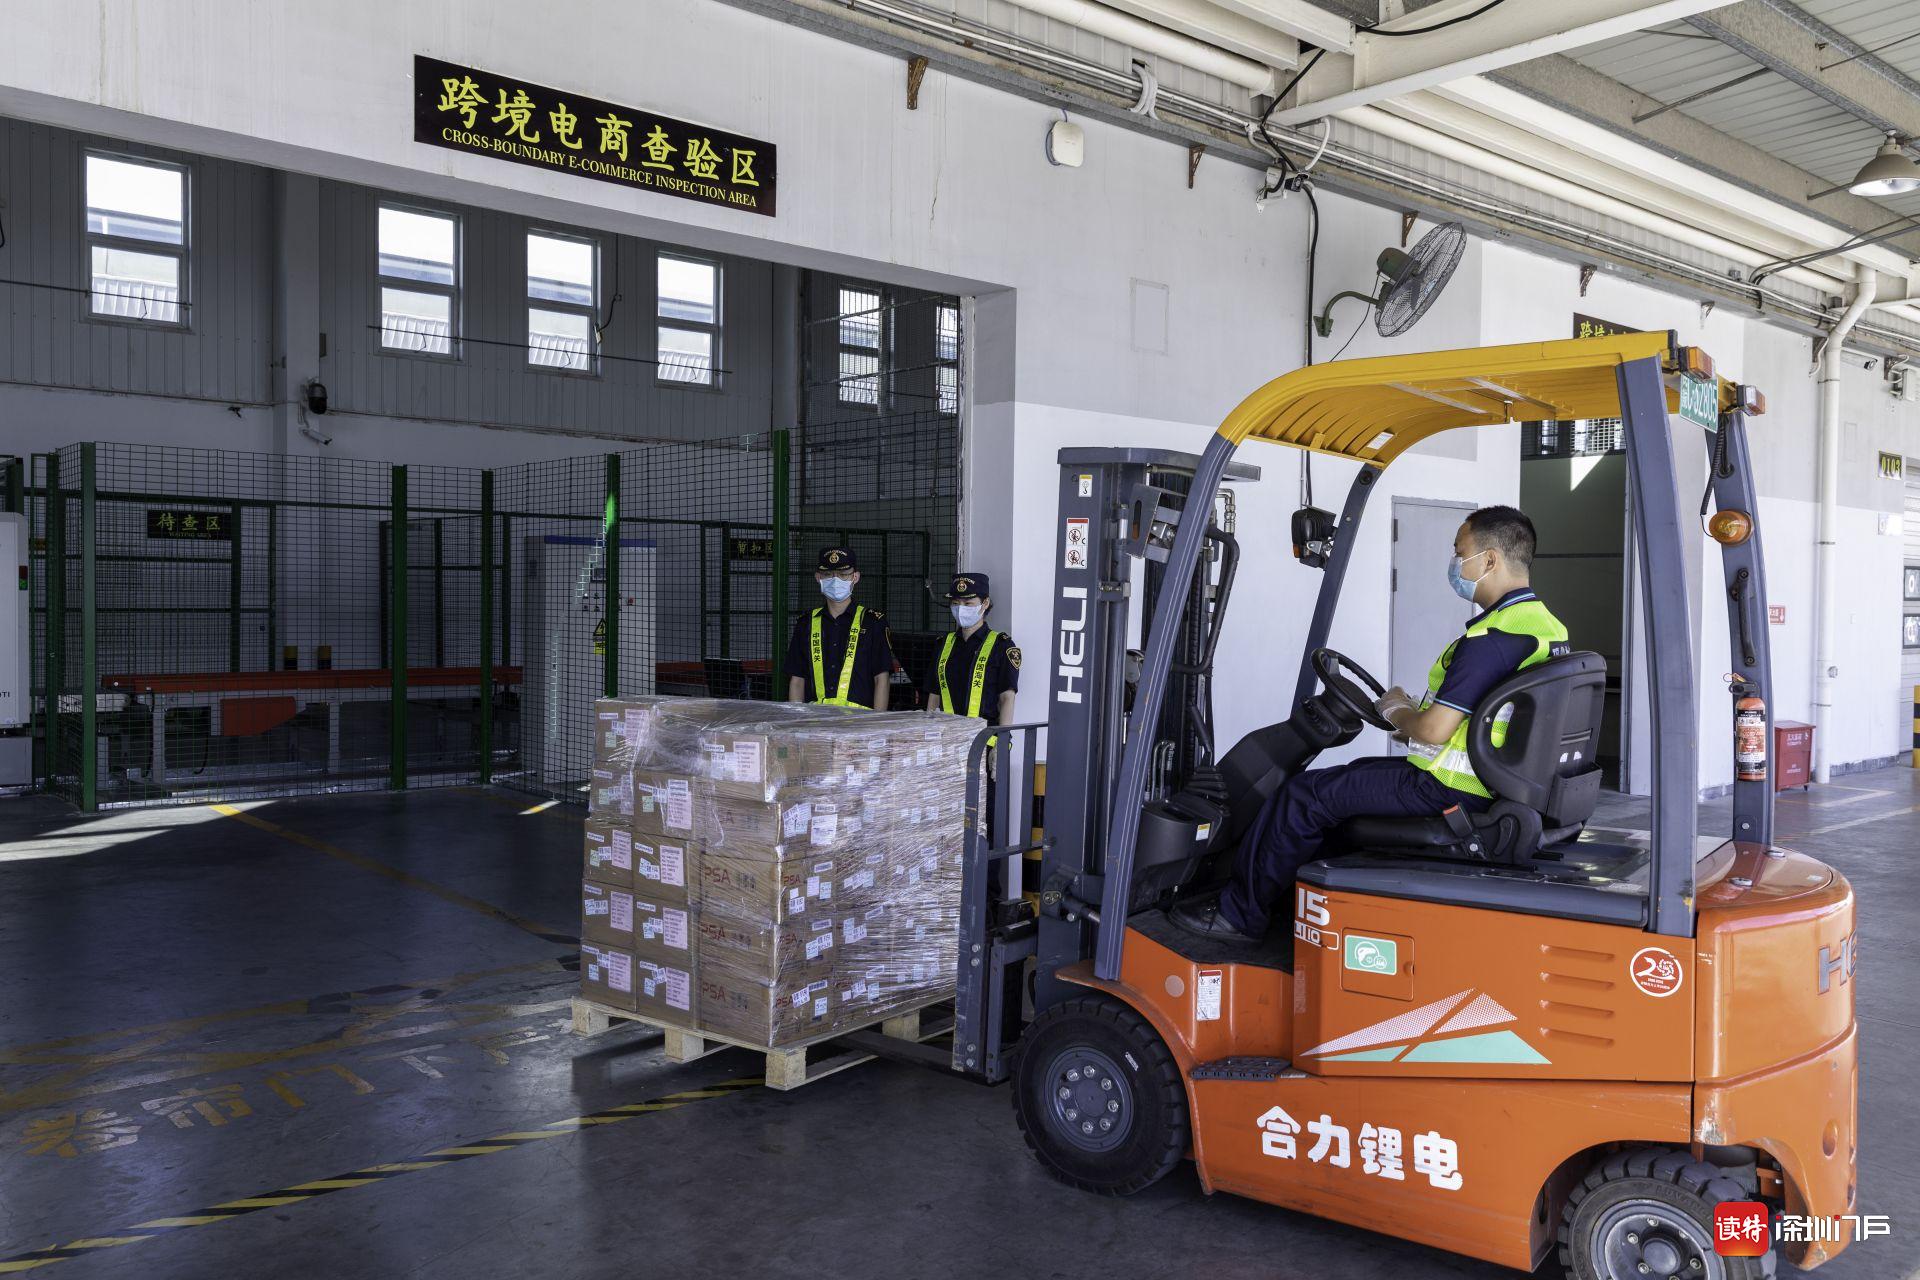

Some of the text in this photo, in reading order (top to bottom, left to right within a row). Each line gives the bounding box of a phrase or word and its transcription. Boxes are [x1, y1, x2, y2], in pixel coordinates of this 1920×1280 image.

[437, 75, 760, 187] 跨境电商查验区
[442, 127, 757, 208] CROSS-BOUNDARY E-COMMERCE INSPECTION AREA
[157, 512, 221, 531] 待查区
[973, 656, 987, 688] 中国海关
[1057, 586, 1088, 704] HELI
[1256, 1105, 1463, 1191] 合力锂电
